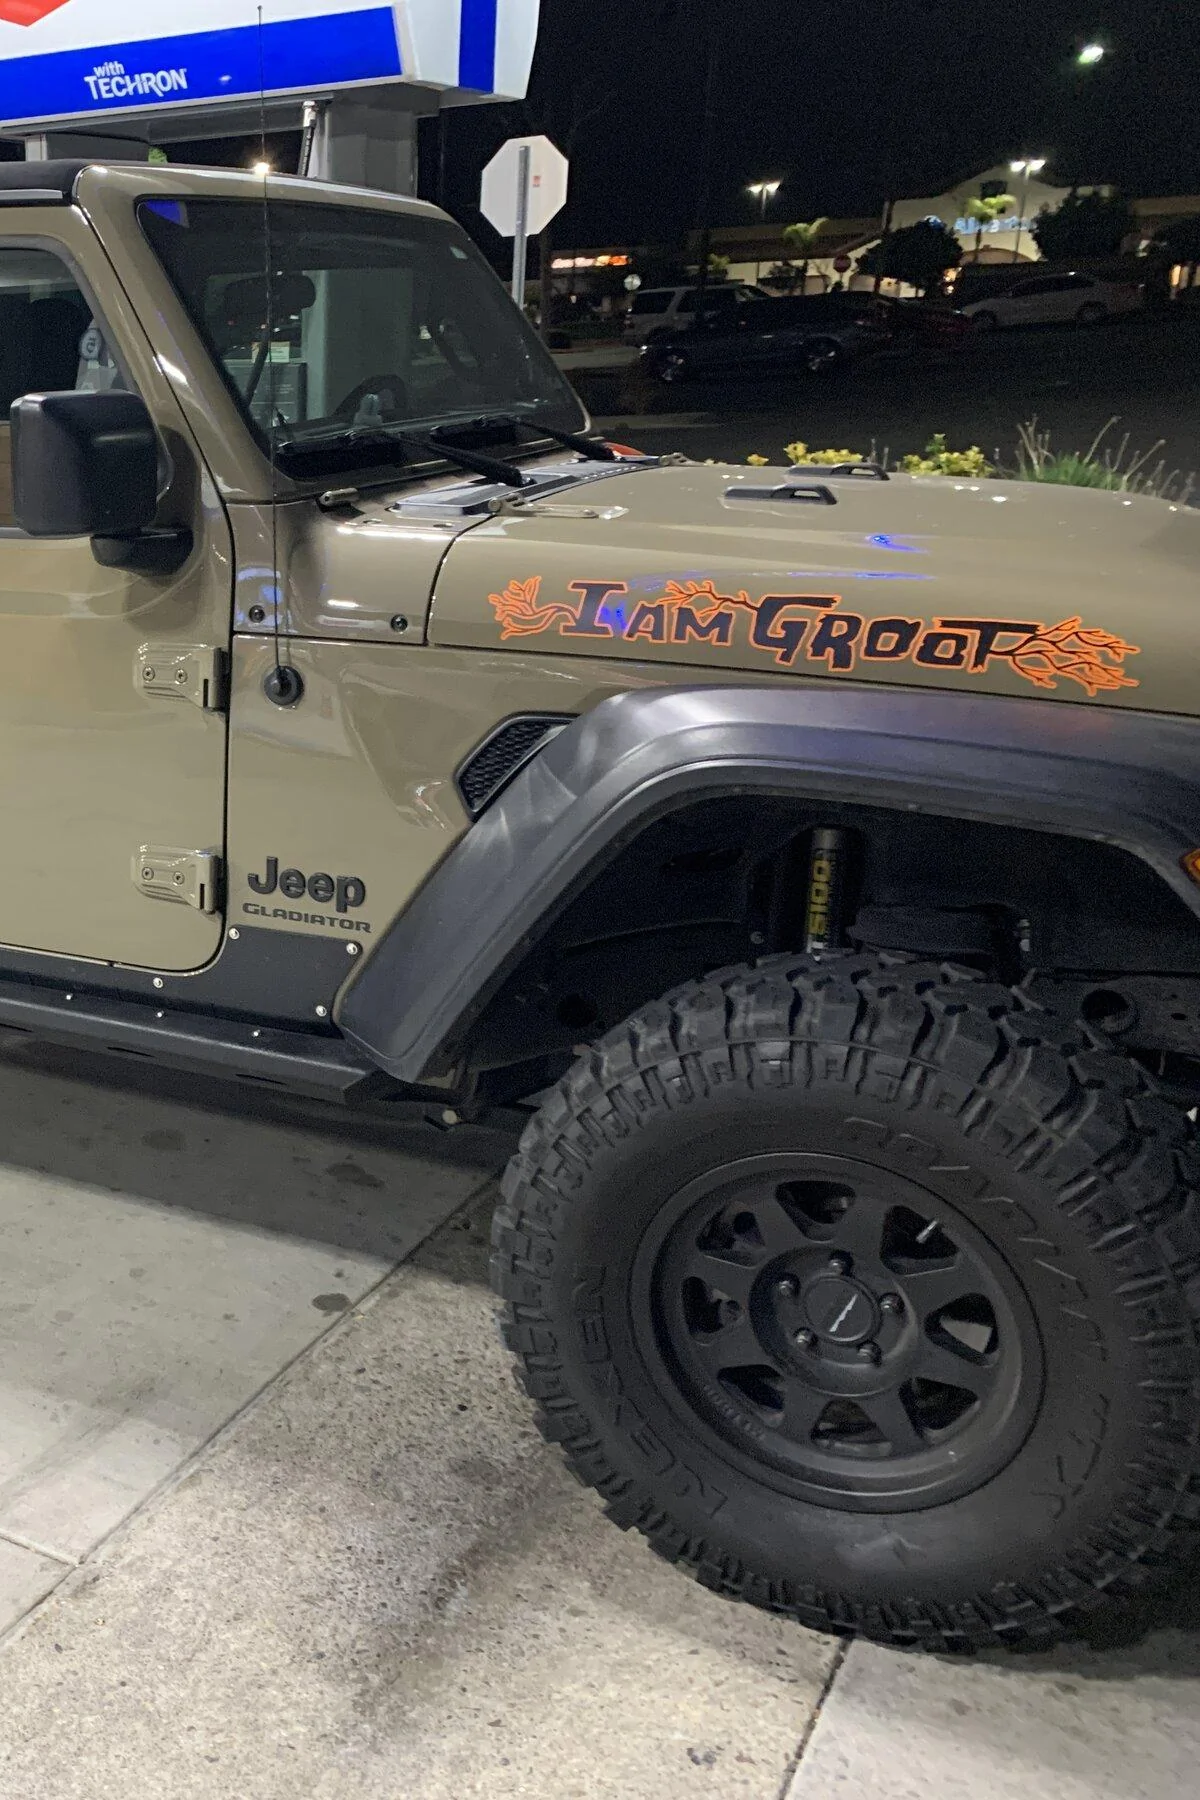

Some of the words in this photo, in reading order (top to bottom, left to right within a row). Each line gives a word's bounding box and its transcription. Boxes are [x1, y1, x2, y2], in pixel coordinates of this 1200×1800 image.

[84, 69, 188, 100] TECHRON
[93, 61, 125, 77] with
[559, 579, 629, 638] I
[624, 600, 734, 647] AM
[749, 593, 1041, 675] GROOT
[247, 855, 366, 913] Jeep
[242, 902, 372, 934] GLADIATOR
